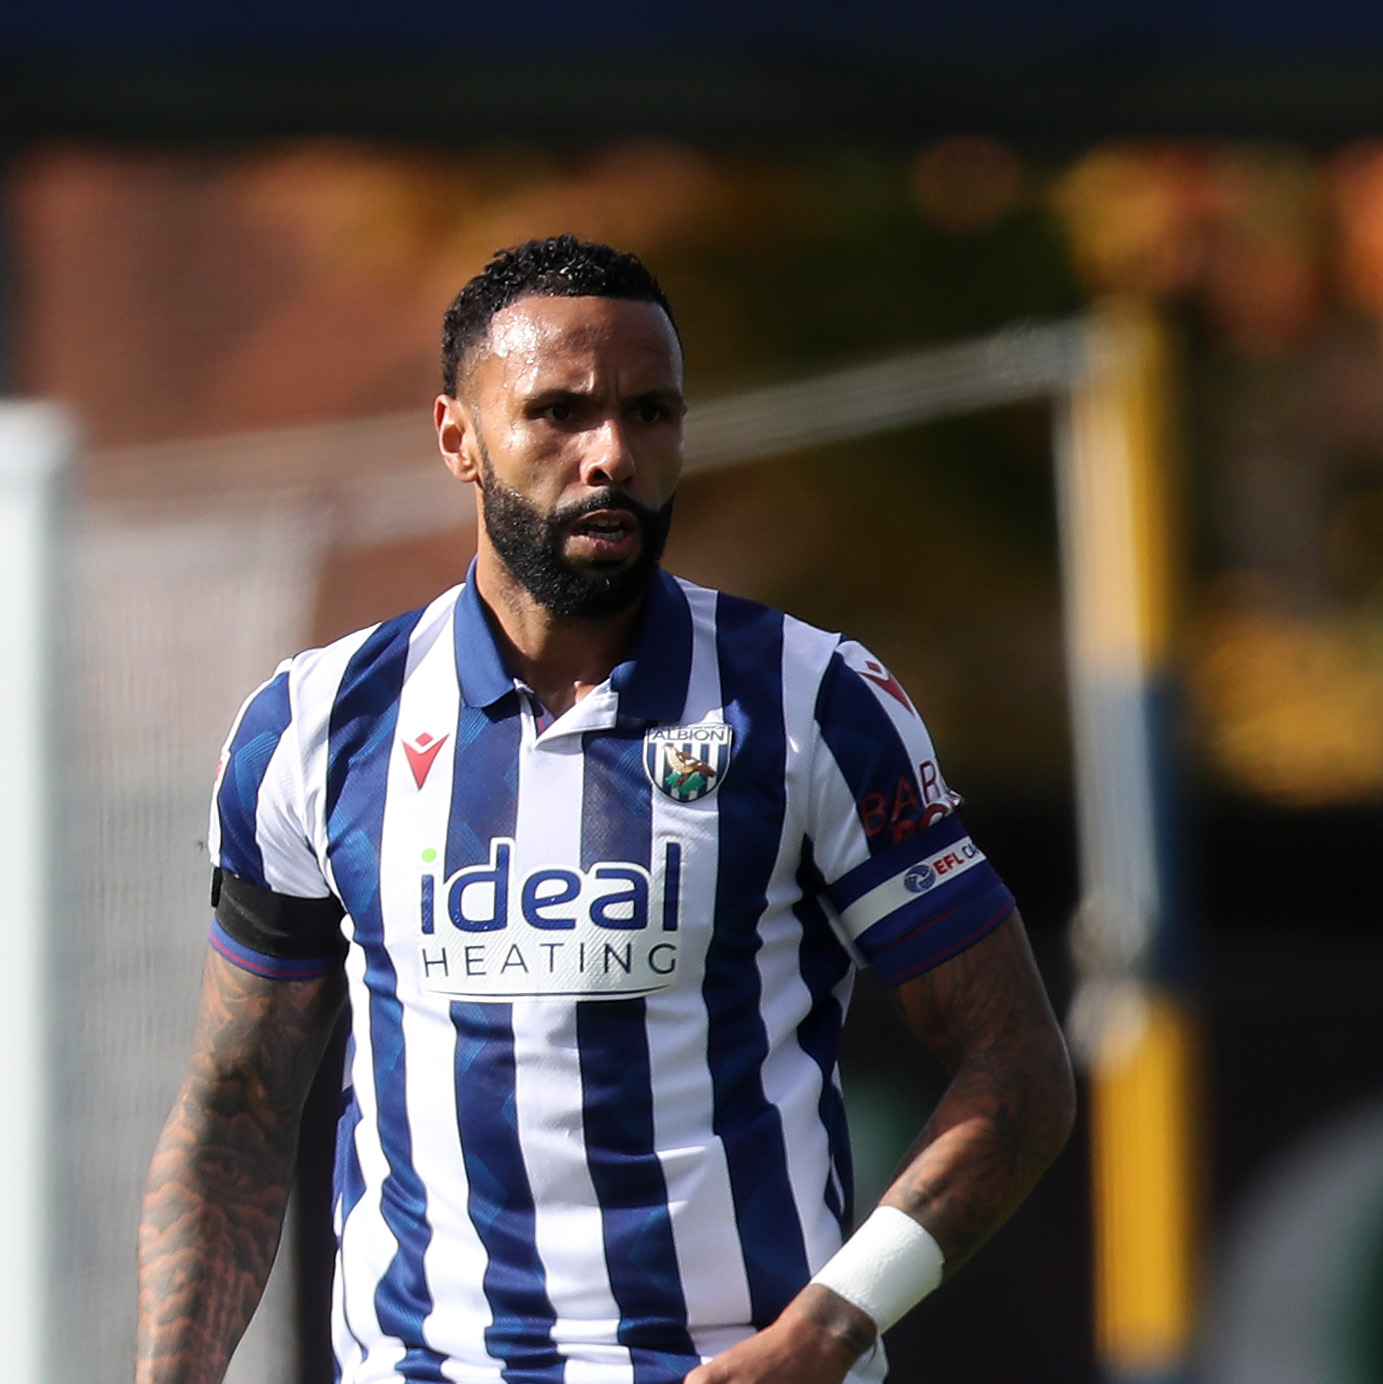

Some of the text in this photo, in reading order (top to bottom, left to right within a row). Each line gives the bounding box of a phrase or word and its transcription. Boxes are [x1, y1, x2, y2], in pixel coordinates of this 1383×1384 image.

[652, 728, 725, 742] ALBION
[933, 852, 965, 876] EFL
[420, 841, 682, 935] ideal
[422, 942, 677, 979] HEATING
